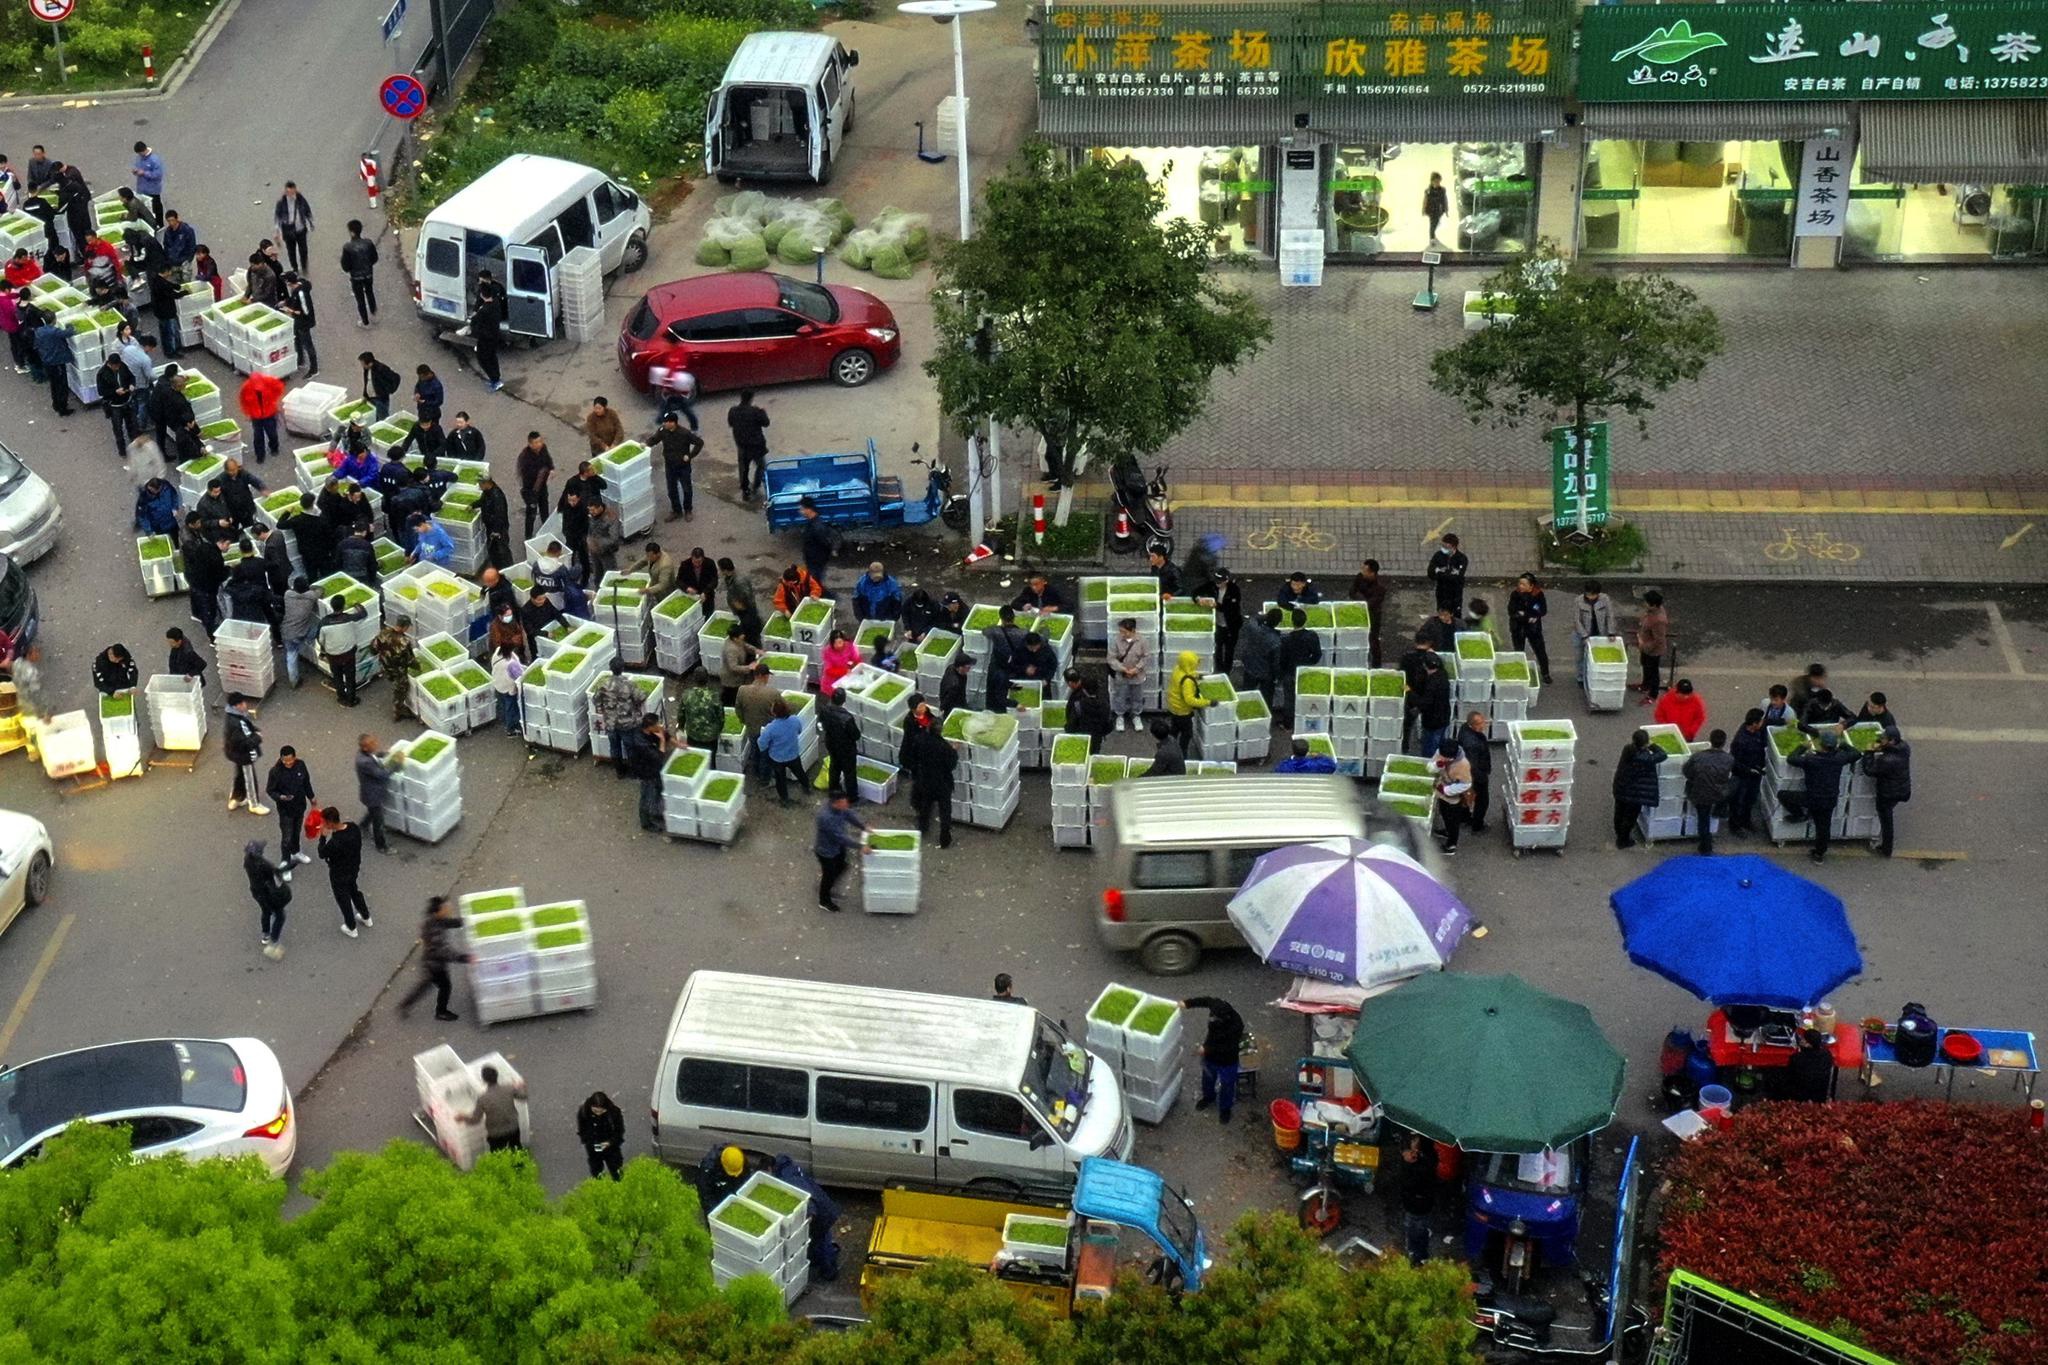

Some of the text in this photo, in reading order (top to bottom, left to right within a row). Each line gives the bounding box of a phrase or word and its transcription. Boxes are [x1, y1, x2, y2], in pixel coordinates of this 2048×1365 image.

[1324, 36, 1550, 77] 欣雅茶场
[1323, 84, 1347, 94] 手机
[1784, 77, 1847, 90] 安吉白茶
[1861, 77, 1921, 90] 自产自销
[1807, 146, 1840, 225] 山香茶场
[800, 630, 814, 643] 12
